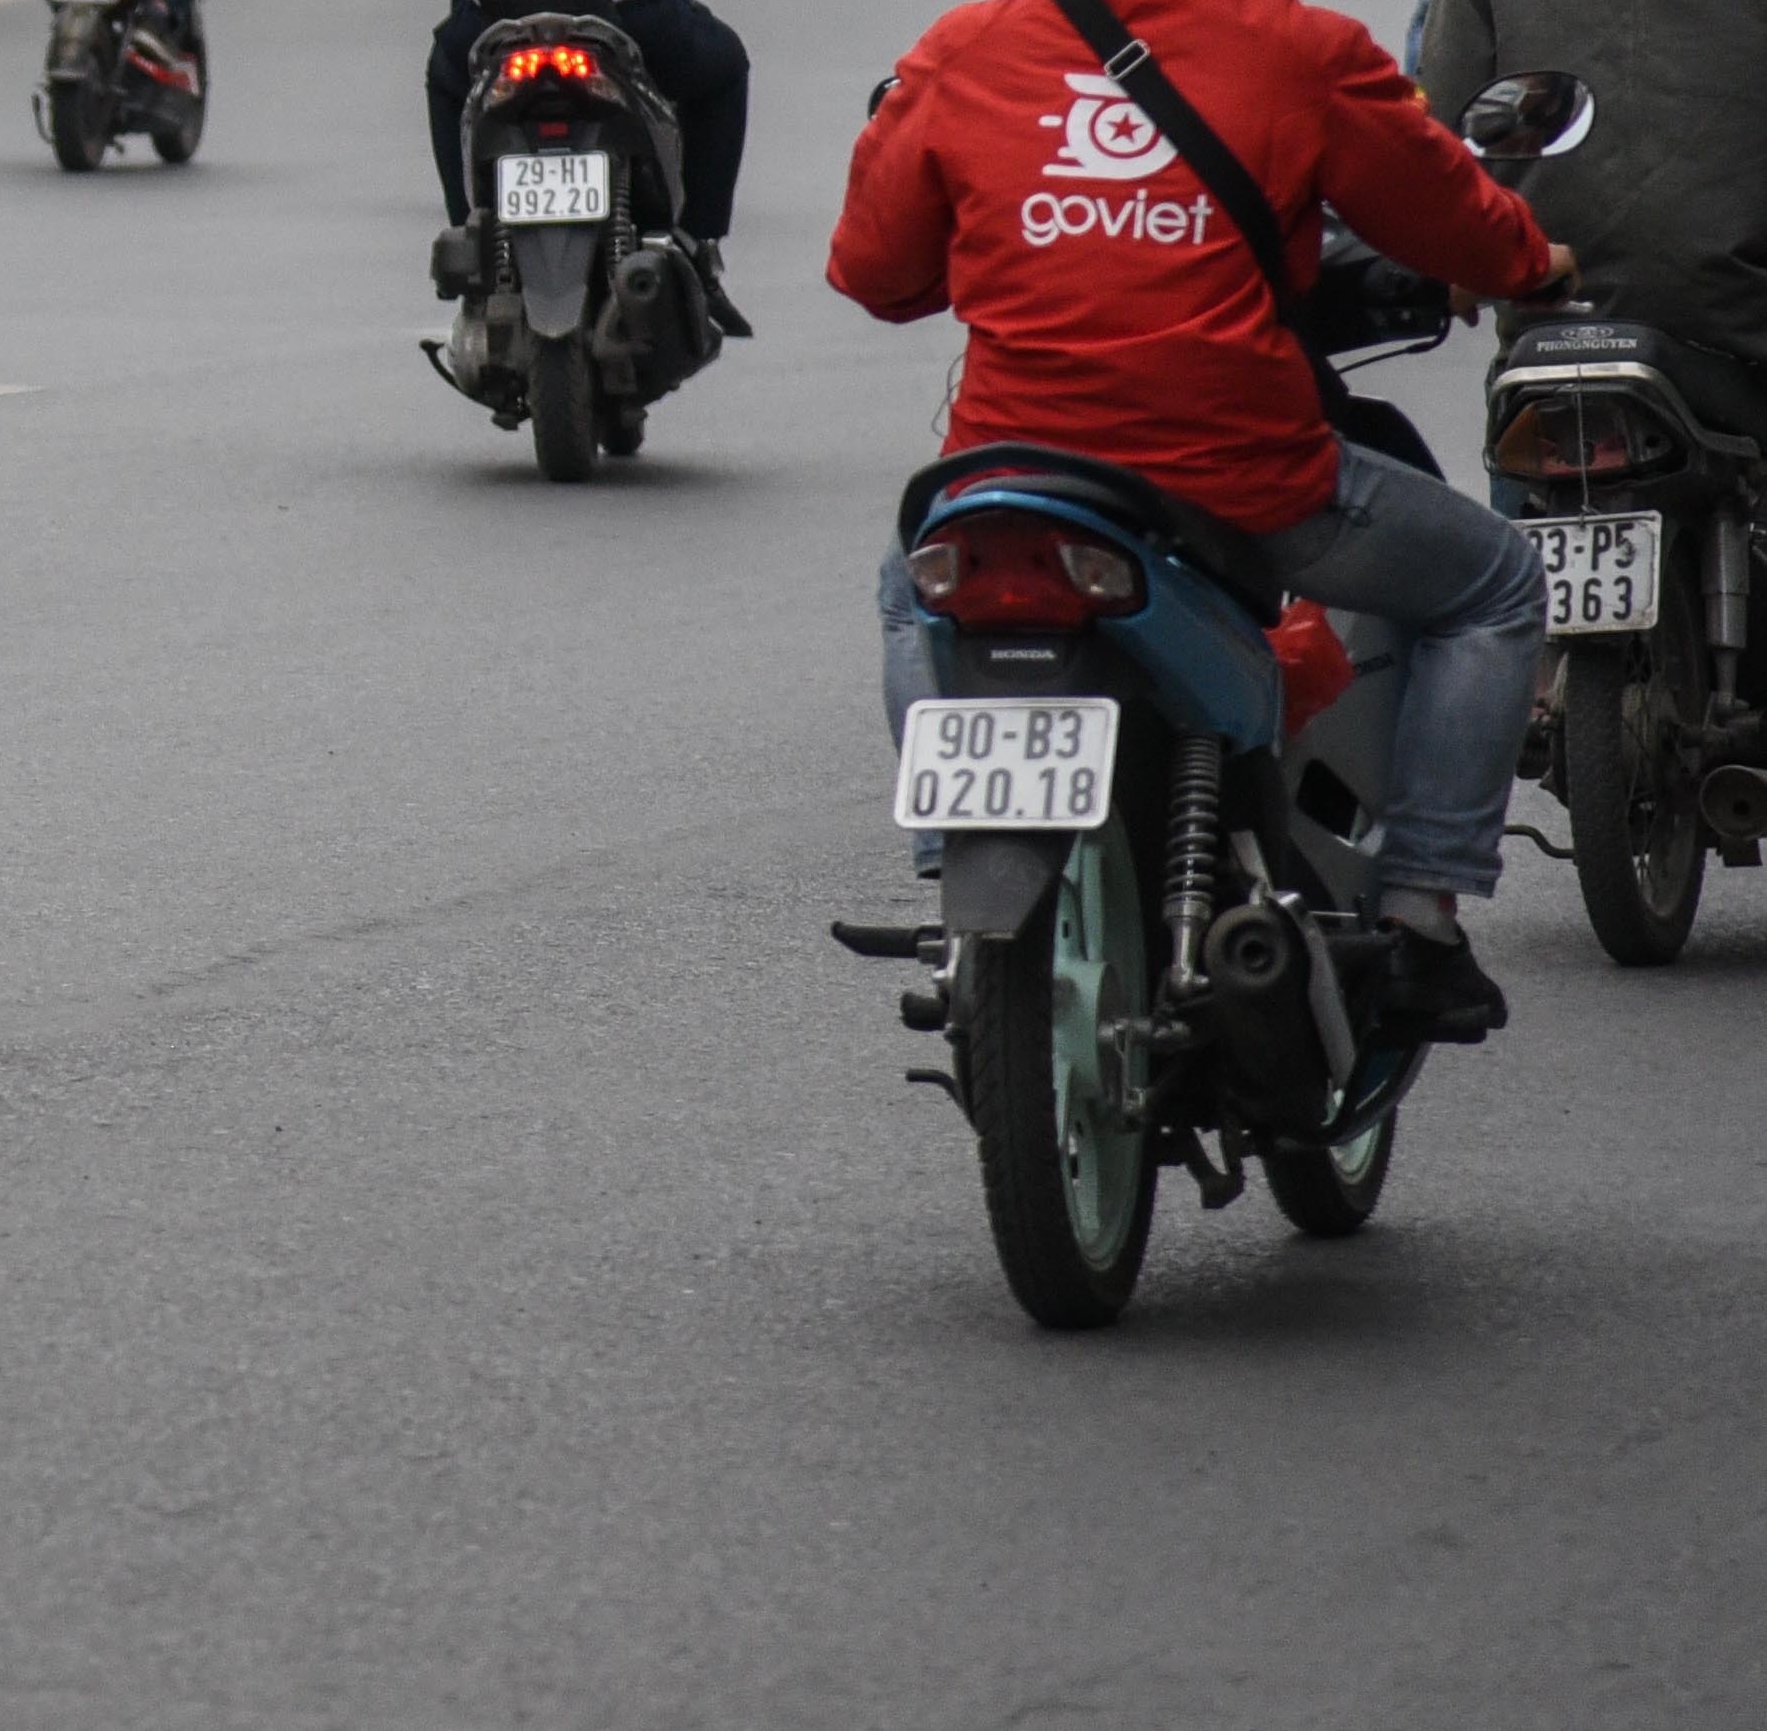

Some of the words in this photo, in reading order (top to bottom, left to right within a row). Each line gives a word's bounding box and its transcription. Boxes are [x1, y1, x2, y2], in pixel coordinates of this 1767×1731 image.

[515, 157, 588, 187] 29-H1
[507, 187, 600, 216] 992.20
[1021, 188, 1215, 247] goviet
[990, 648, 1056, 661] HONDA
[937, 708, 1084, 761] 90-B3
[912, 766, 1096, 821] 020.18
